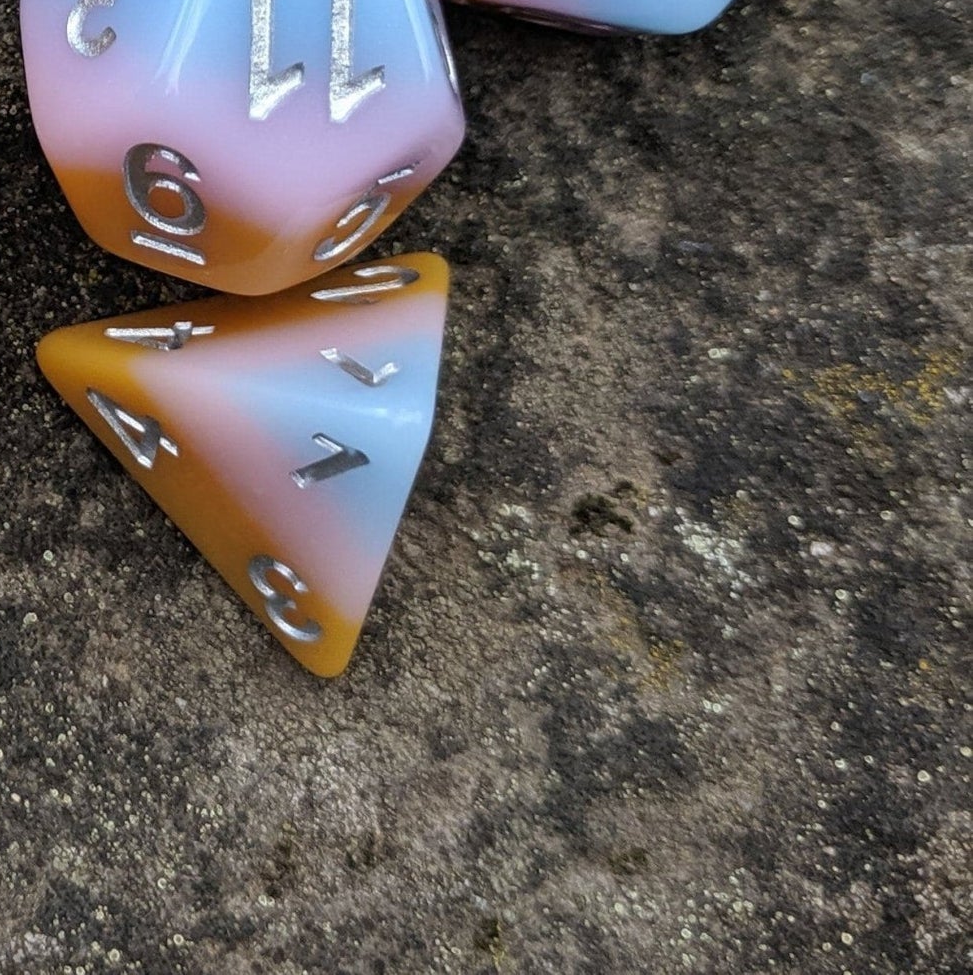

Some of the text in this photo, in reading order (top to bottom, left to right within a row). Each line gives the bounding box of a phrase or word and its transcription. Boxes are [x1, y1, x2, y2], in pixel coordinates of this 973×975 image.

[319, 347, 401, 388] 1
[86, 387, 180, 470] 4
[288, 432, 371, 489] 1
[247, 555, 323, 644] 3
